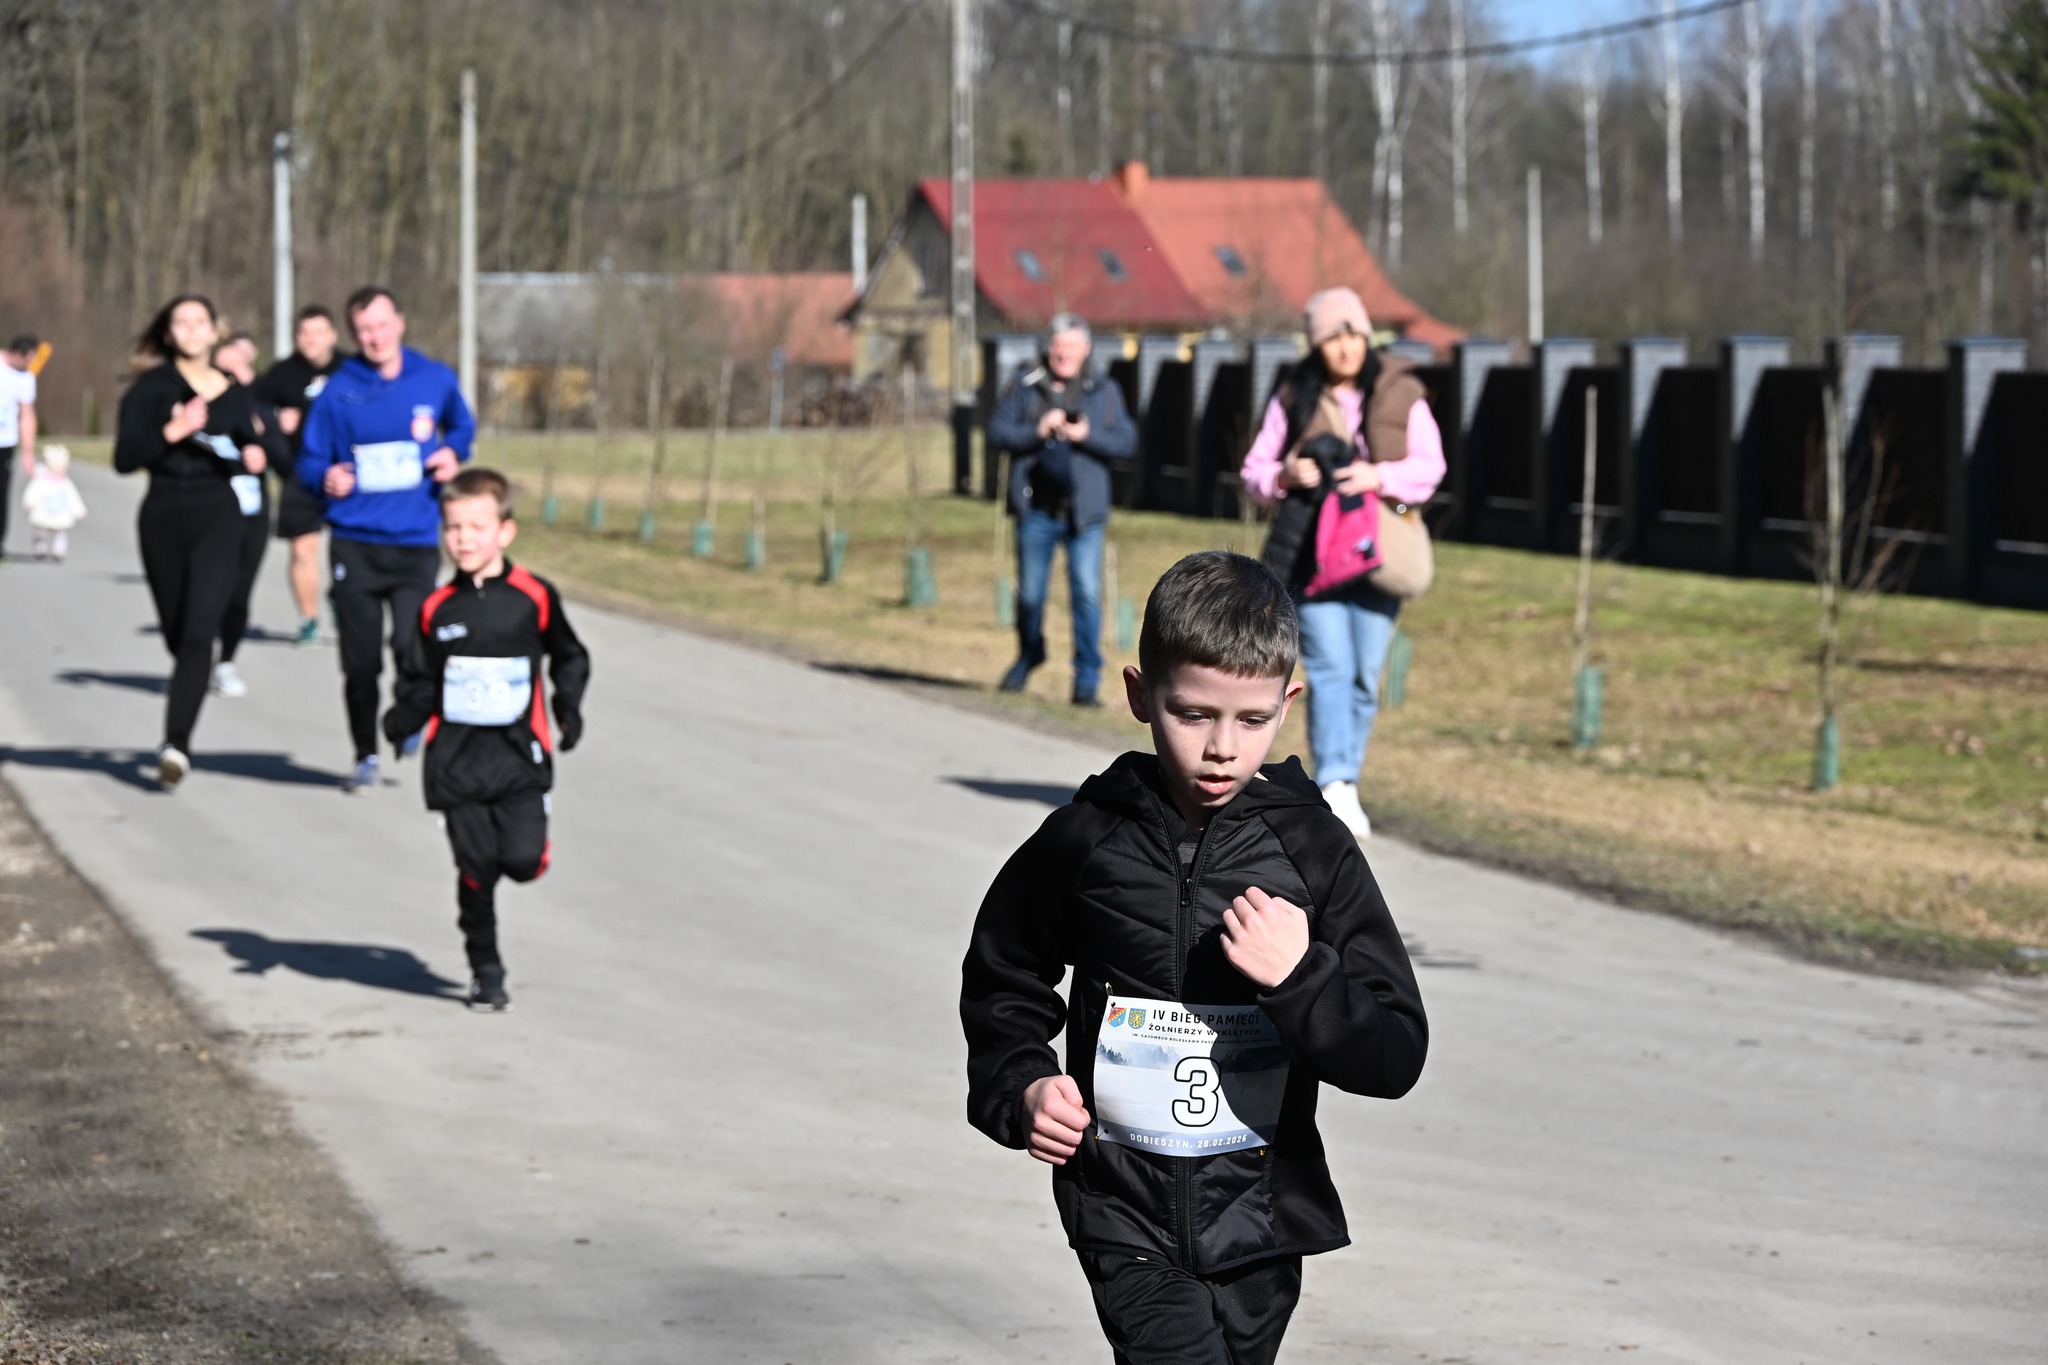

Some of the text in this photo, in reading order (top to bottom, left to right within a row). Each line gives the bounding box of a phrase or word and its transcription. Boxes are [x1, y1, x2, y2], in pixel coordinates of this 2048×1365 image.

[1153, 1009, 1259, 1025] IV BIEG PAMIĘCI
[1148, 1023, 1261, 1037] ŻOŁNIERZY WYKLĘTYCH
[1172, 1056, 1221, 1127] 3
[1130, 1133, 1192, 1149] DOBIESZYN,
